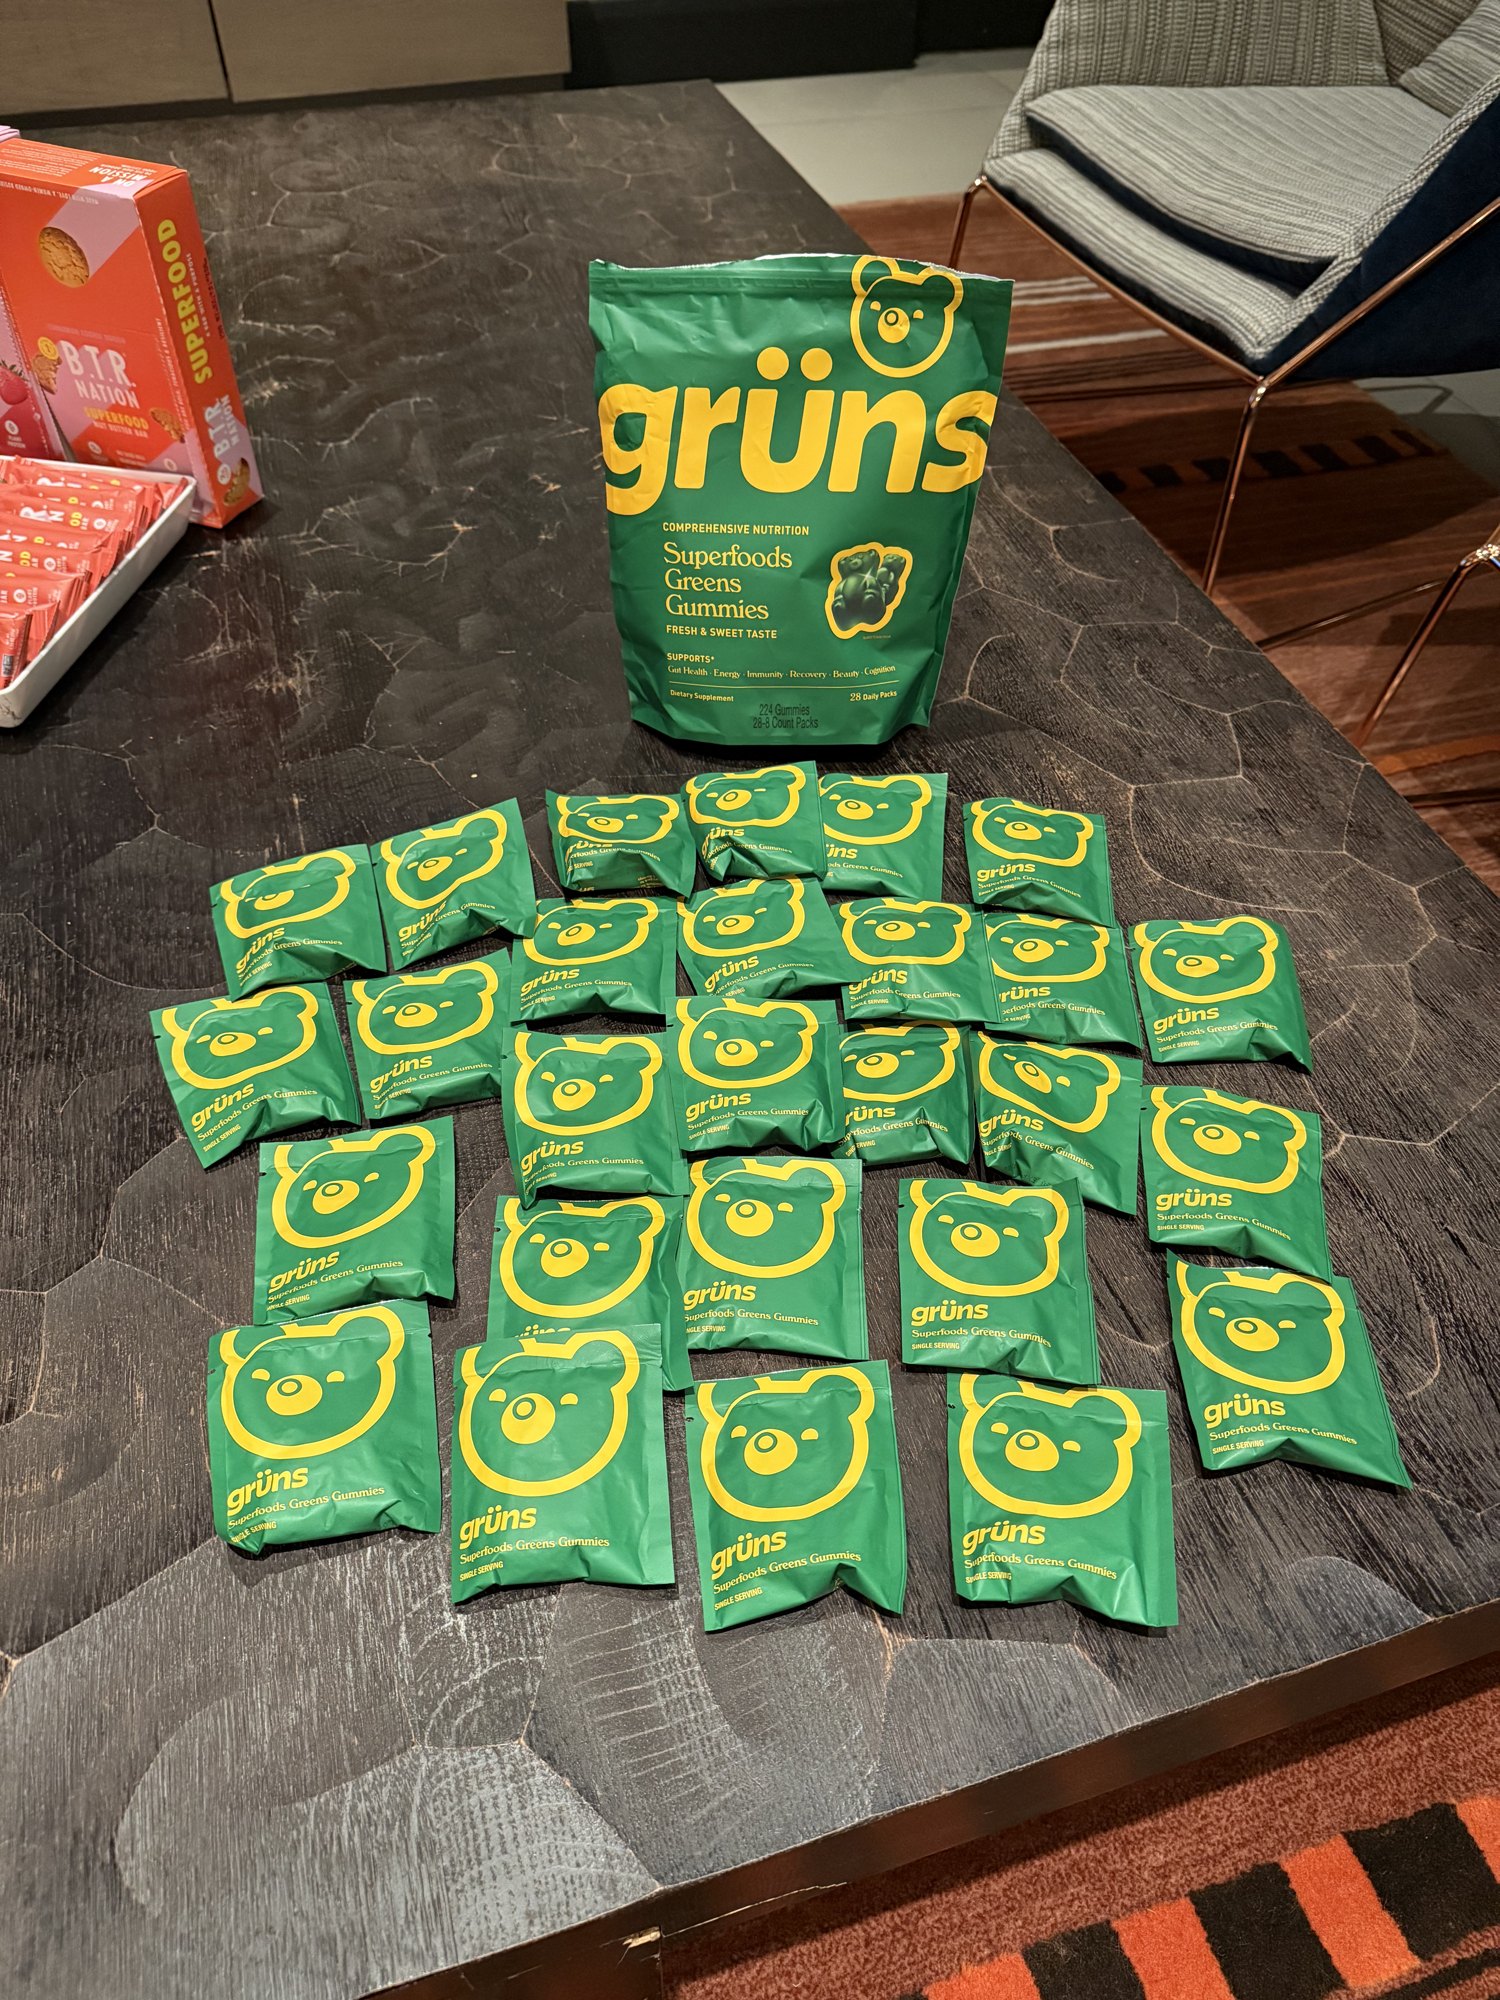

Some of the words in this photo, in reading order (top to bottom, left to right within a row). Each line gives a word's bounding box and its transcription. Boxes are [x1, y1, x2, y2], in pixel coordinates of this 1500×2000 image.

[89, 166, 149, 181] MISSION
[157, 219, 213, 384] SUPERFOOD
[74, 379, 140, 409] NATION
[84, 406, 149, 430] SUPERFOOD
[220, 394, 241, 448] NATION
[598, 346, 998, 516] grüns
[662, 522, 750, 534] COMPREHENSIVE
[752, 525, 809, 536] NUTRITION
[663, 541, 793, 569] Superfoods
[664, 568, 742, 593] Greens
[665, 593, 769, 619] Gummies
[666, 624, 697, 636] FRESH
[700, 627, 707, 636] &
[710, 627, 743, 638] SWEET
[746, 629, 777, 639] TASTE
[667, 665, 681, 674] Gut
[683, 666, 707, 676] Health
[713, 668, 740, 679] Energy
[747, 670, 783, 679] Immunity
[789, 670, 827, 680] Recovery
[833, 670, 860, 679] Beauty
[864, 665, 896, 676] Cognition
[670, 689, 693, 699] Dietary
[694, 692, 734, 702] Supplement
[849, 692, 861, 702] 28
[863, 693, 879, 701] Daily
[880, 690, 897, 699] Packs
[759, 703, 773, 716] 224
[775, 703, 810, 716] Gummies
[752, 716, 770, 729] 28-8
[771, 716, 795, 729] Count
[796, 717, 819, 729] Packs
[826, 844, 858, 859] üns
[843, 862, 869, 870] Greens
[870, 865, 903, 878] Gummies
[976, 863, 1036, 882] grüns
[978, 875, 1021, 889] Superfoods
[1022, 875, 1049, 885] Greens
[1050, 881, 1081, 898] Gummies
[398, 901, 446, 942] grüns
[435, 908, 460, 922] Greens
[461, 902, 496, 910] Gummies
[235, 927, 285, 974] grüns
[273, 940, 301, 951] Greens
[520, 969, 580, 997] grüns
[704, 955, 759, 992] grüns
[750, 966, 776, 978] Greens
[521, 984, 562, 1003] Superfoods
[564, 980, 592, 989] Greens
[850, 987, 894, 1002] Superfoods
[895, 989, 921, 999] Greens
[923, 990, 961, 998] Gummies
[999, 986, 1051, 1003] rüns
[1037, 1001, 1065, 1009] Greens
[1067, 1003, 1105, 1015] Gummies
[1153, 1007, 1219, 1035] grüns
[1156, 1028, 1205, 1043] Superfoods
[1206, 1024, 1238, 1033] Greens
[1240, 1021, 1278, 1031] Gummies
[369, 1055, 433, 1093] grüns
[419, 1069, 450, 1080] Greens
[452, 1063, 492, 1073] Gummies
[191, 1083, 255, 1133] grüns
[198, 1109, 241, 1141] Superfoods
[242, 1093, 272, 1111] Greens
[274, 1089, 318, 1099] Gummies
[685, 1093, 752, 1123] grüns
[687, 1112, 735, 1131] Superfoods
[770, 1108, 809, 1116] Gummies
[845, 1106, 896, 1126] rüns
[221, 1124, 241, 1140] SERVING
[706, 1124, 730, 1135] SERVING
[883, 1121, 914, 1131] Greens
[915, 1118, 948, 1132] Gummies
[979, 1109, 1044, 1137] grüns
[520, 1141, 584, 1177] grüns
[601, 1157, 644, 1165] Gummies
[1025, 1135, 1054, 1152] Greens
[1055, 1147, 1094, 1170] Gummies
[1156, 1188, 1232, 1211] grüns
[1156, 1212, 1213, 1221] Superfoods
[1215, 1212, 1250, 1223] Greens
[1251, 1218, 1292, 1241] Gummies
[267, 1279, 318, 1304] Superfoods
[320, 1268, 354, 1282] Greens
[356, 1260, 403, 1273] Gummies
[268, 1251, 340, 1294] grüns
[285, 1294, 310, 1307] SERVING
[683, 1280, 756, 1311] grüns
[684, 1309, 735, 1323] Superfoods
[737, 1308, 771, 1320] Greens
[773, 1313, 818, 1326] Gummies
[911, 1299, 989, 1327] grüns
[911, 1327, 969, 1338] Superfoods
[970, 1326, 1006, 1338] Greens
[1008, 1330, 1052, 1348] Gummies
[911, 1342, 933, 1350] SINGLE
[934, 1342, 960, 1350] SERVING
[1204, 1393, 1286, 1429] grüns
[1209, 1423, 1271, 1441] Superfoods
[1272, 1422, 1310, 1434] Greens
[1311, 1428, 1357, 1445] Gummies
[1212, 1443, 1235, 1455] SINGLE
[1236, 1440, 1264, 1449] SERVING
[226, 1467, 308, 1516] grüns
[228, 1502, 286, 1530] Superfoods
[289, 1494, 329, 1509] Greens
[331, 1486, 385, 1501] Gummies
[250, 1521, 277, 1533] SERVING
[459, 1505, 537, 1550] grüns
[962, 1520, 1046, 1556] grüns
[460, 1542, 513, 1565] Superfoods
[515, 1540, 555, 1550] Greens
[558, 1536, 610, 1547] Gummies
[711, 1531, 787, 1581] grüns
[459, 1569, 477, 1581] SINGLE
[477, 1561, 504, 1574] SERVING
[713, 1566, 767, 1594] Superfoods
[768, 1557, 807, 1573] Greens
[809, 1551, 862, 1564] Gummies
[964, 1551, 1021, 1569] Superfoods
[1024, 1554, 1065, 1567] Greens
[1067, 1558, 1117, 1580] Gummies
[965, 1572, 987, 1584] SINGLE
[987, 1571, 1013, 1581] SERVING
[714, 1597, 734, 1611] SINGLE
[734, 1587, 763, 1602] SERVING
